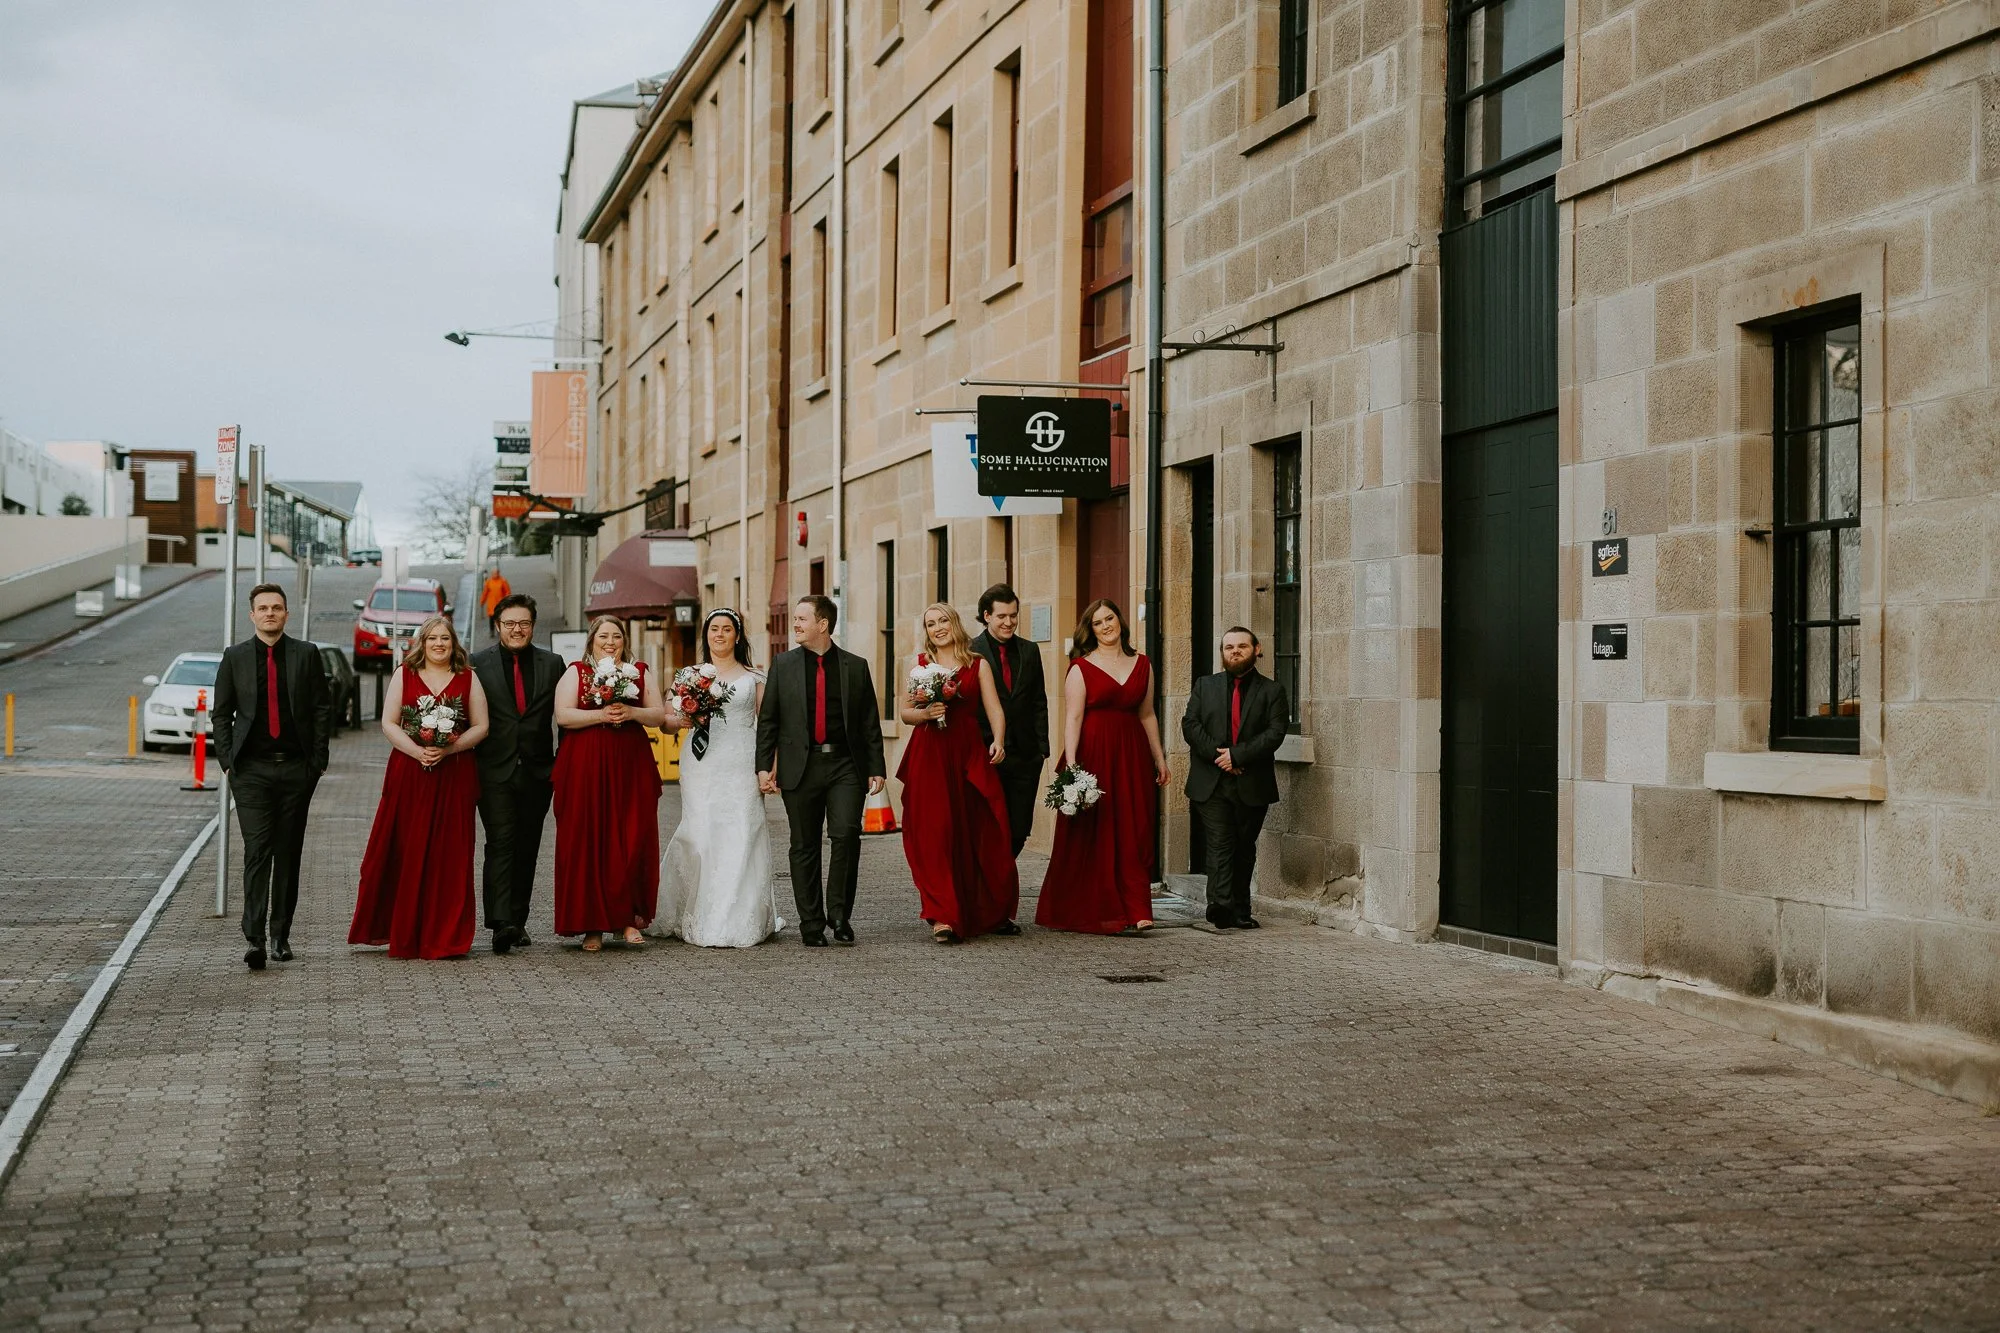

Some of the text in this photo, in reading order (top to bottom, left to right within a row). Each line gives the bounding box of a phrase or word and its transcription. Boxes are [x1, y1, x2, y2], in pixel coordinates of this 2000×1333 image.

[218, 441, 236, 452] ZONE
[980, 455, 1108, 467] SOME HALLUCINATION
[1602, 508, 1617, 535] 81
[1598, 544, 1620, 560] sgfleet
